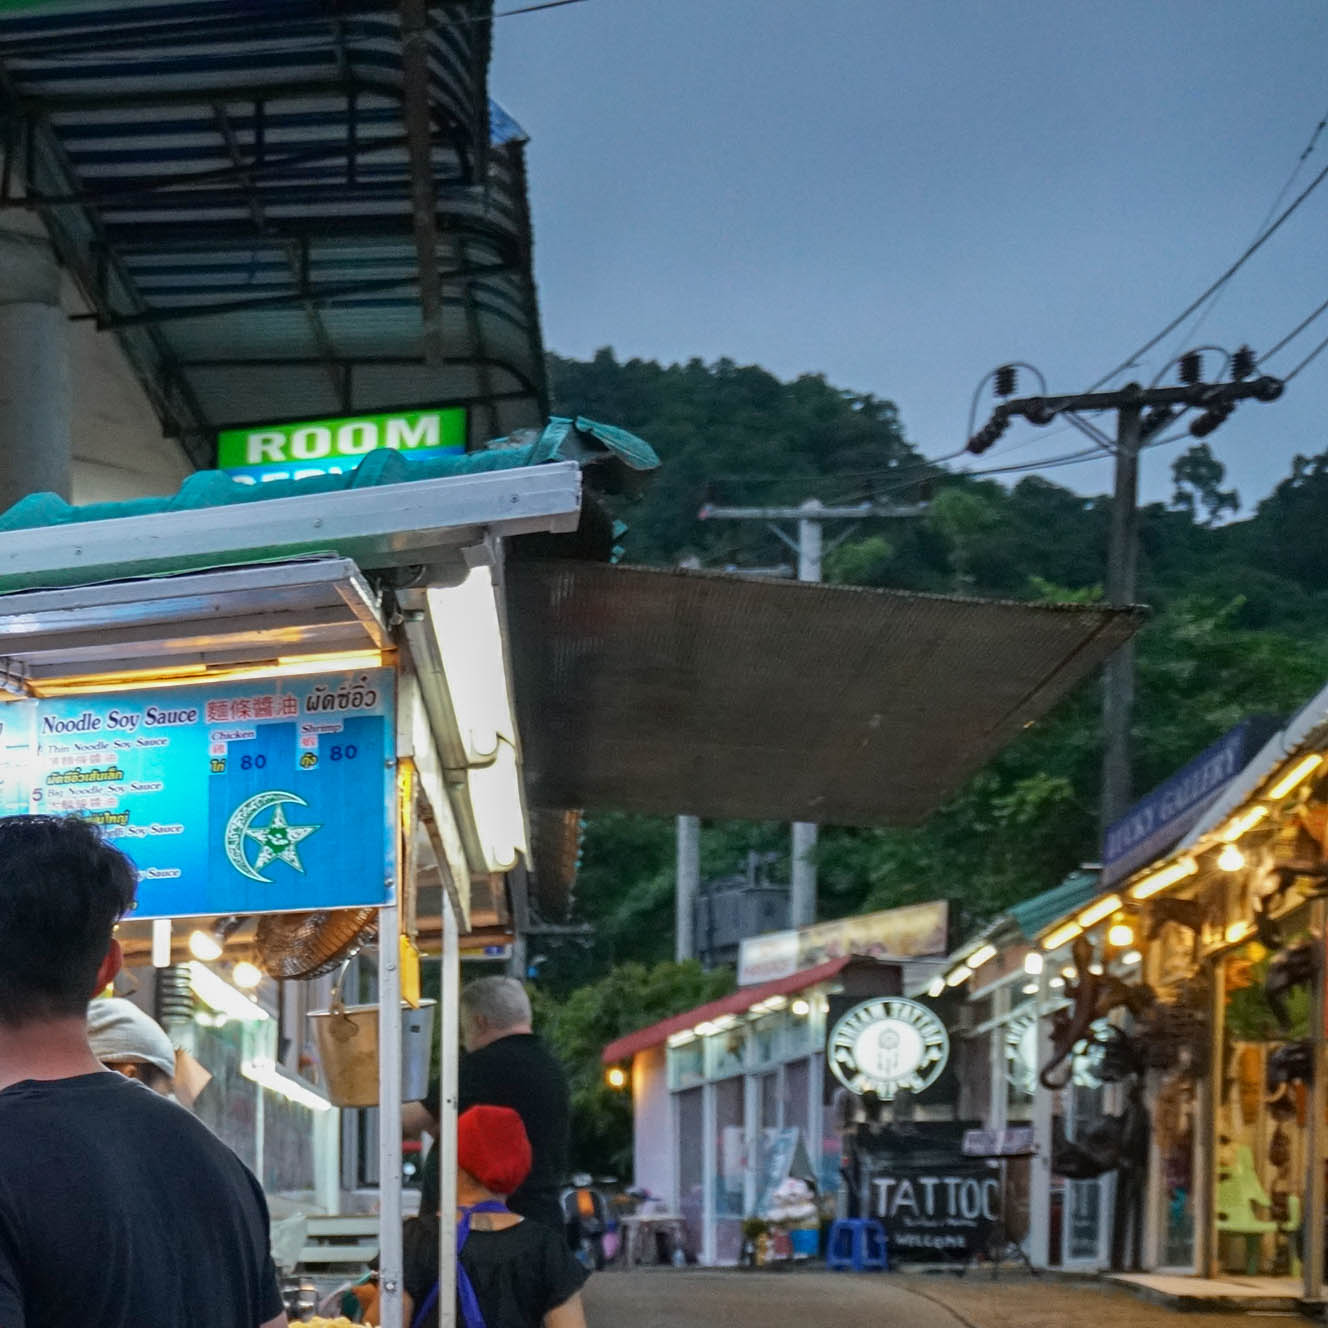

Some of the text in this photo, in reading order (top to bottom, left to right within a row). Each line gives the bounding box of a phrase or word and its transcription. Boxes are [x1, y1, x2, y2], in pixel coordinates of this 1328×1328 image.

[246, 413, 441, 465] ROOM
[42, 707, 198, 736] Noodle Soy Sauce
[211, 729, 255, 742] Chicken
[240, 754, 267, 771] 80
[330, 746, 358, 762] 80
